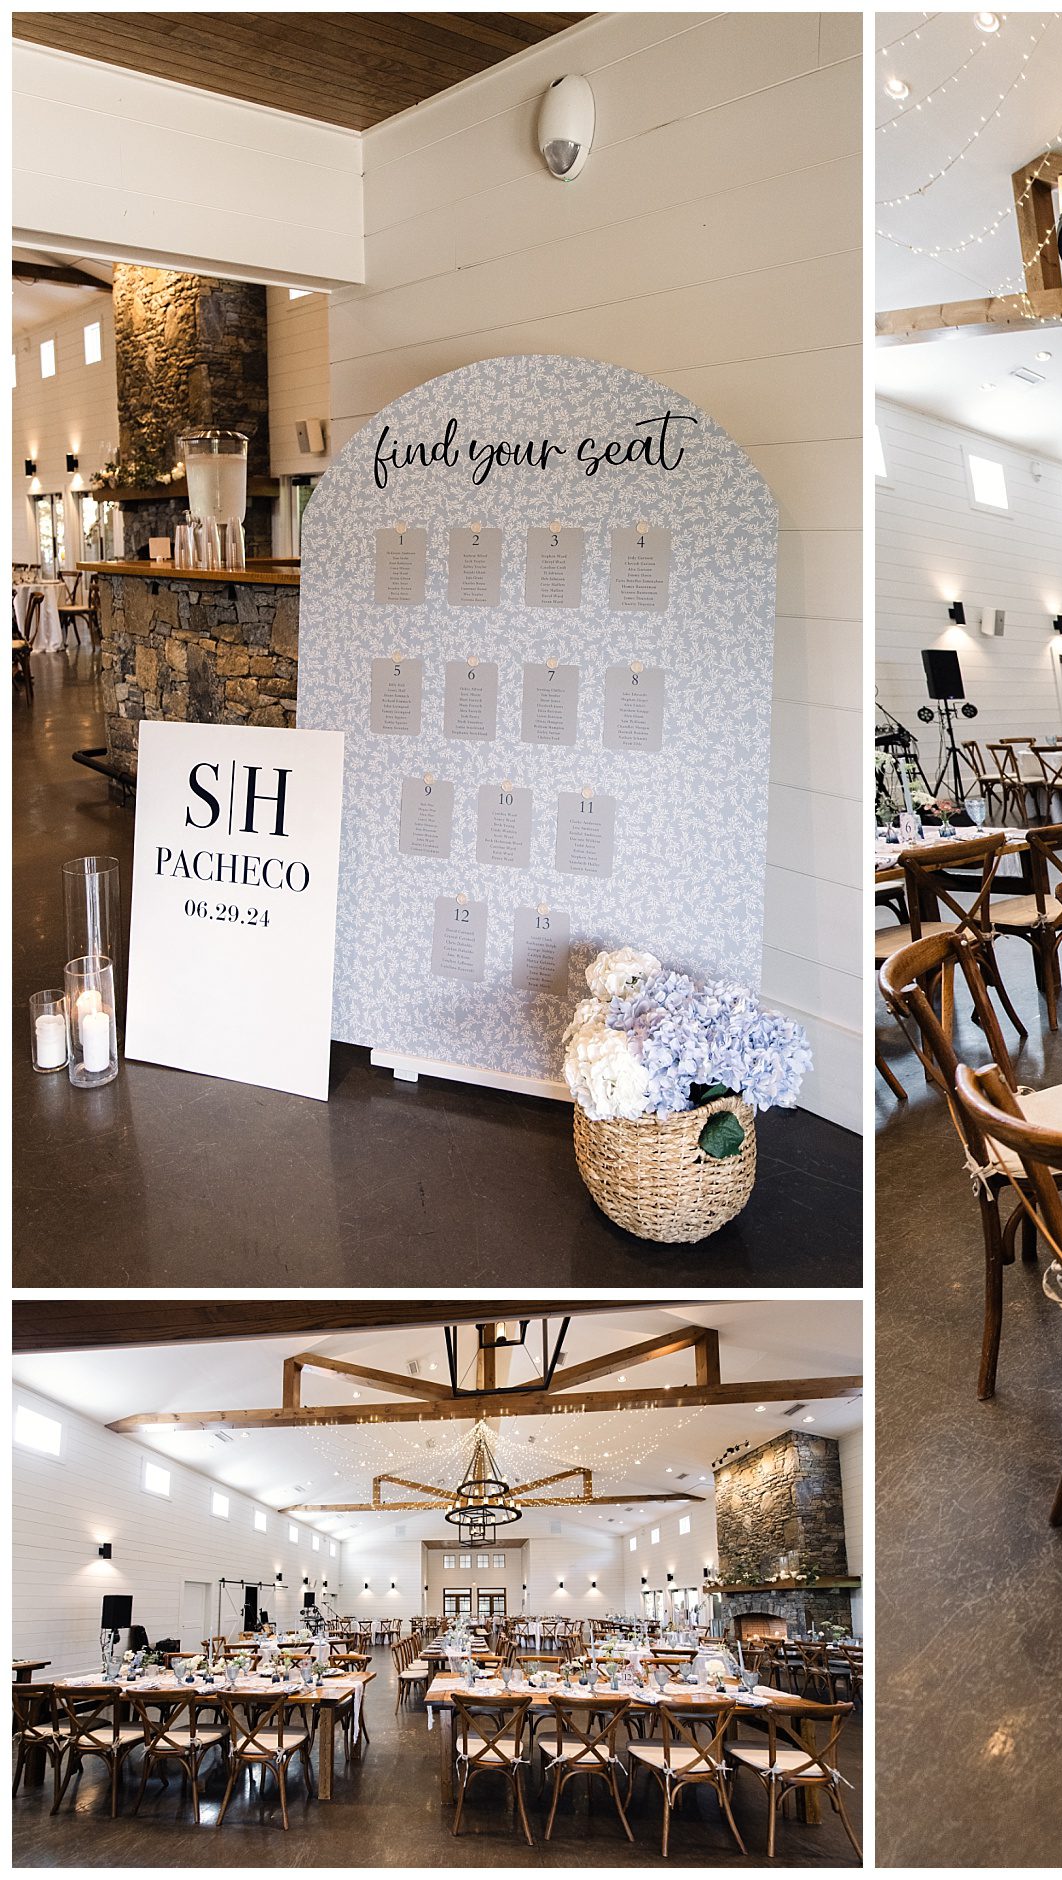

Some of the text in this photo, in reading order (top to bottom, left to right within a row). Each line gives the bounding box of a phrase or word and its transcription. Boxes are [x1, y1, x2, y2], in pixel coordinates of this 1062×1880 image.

[374, 410, 699, 490] find your seat
[472, 534, 480, 546] 2
[550, 534, 559, 547] 3
[636, 535, 646, 548] 4
[393, 664, 401, 676] 5
[467, 668, 476, 680] 6
[547, 670, 556, 682] 7
[631, 673, 639, 686] 8
[424, 785, 432, 797] 9
[498, 793, 514, 806] 10
[579, 800, 593, 814] 11
[905, 821, 912, 834] 6
[154, 846, 311, 893] PACHECO
[184, 899, 271, 928] 06.29.24
[454, 908, 470, 923] 12
[535, 916, 550, 930] 13
[623, 1673, 632, 1681] 12
